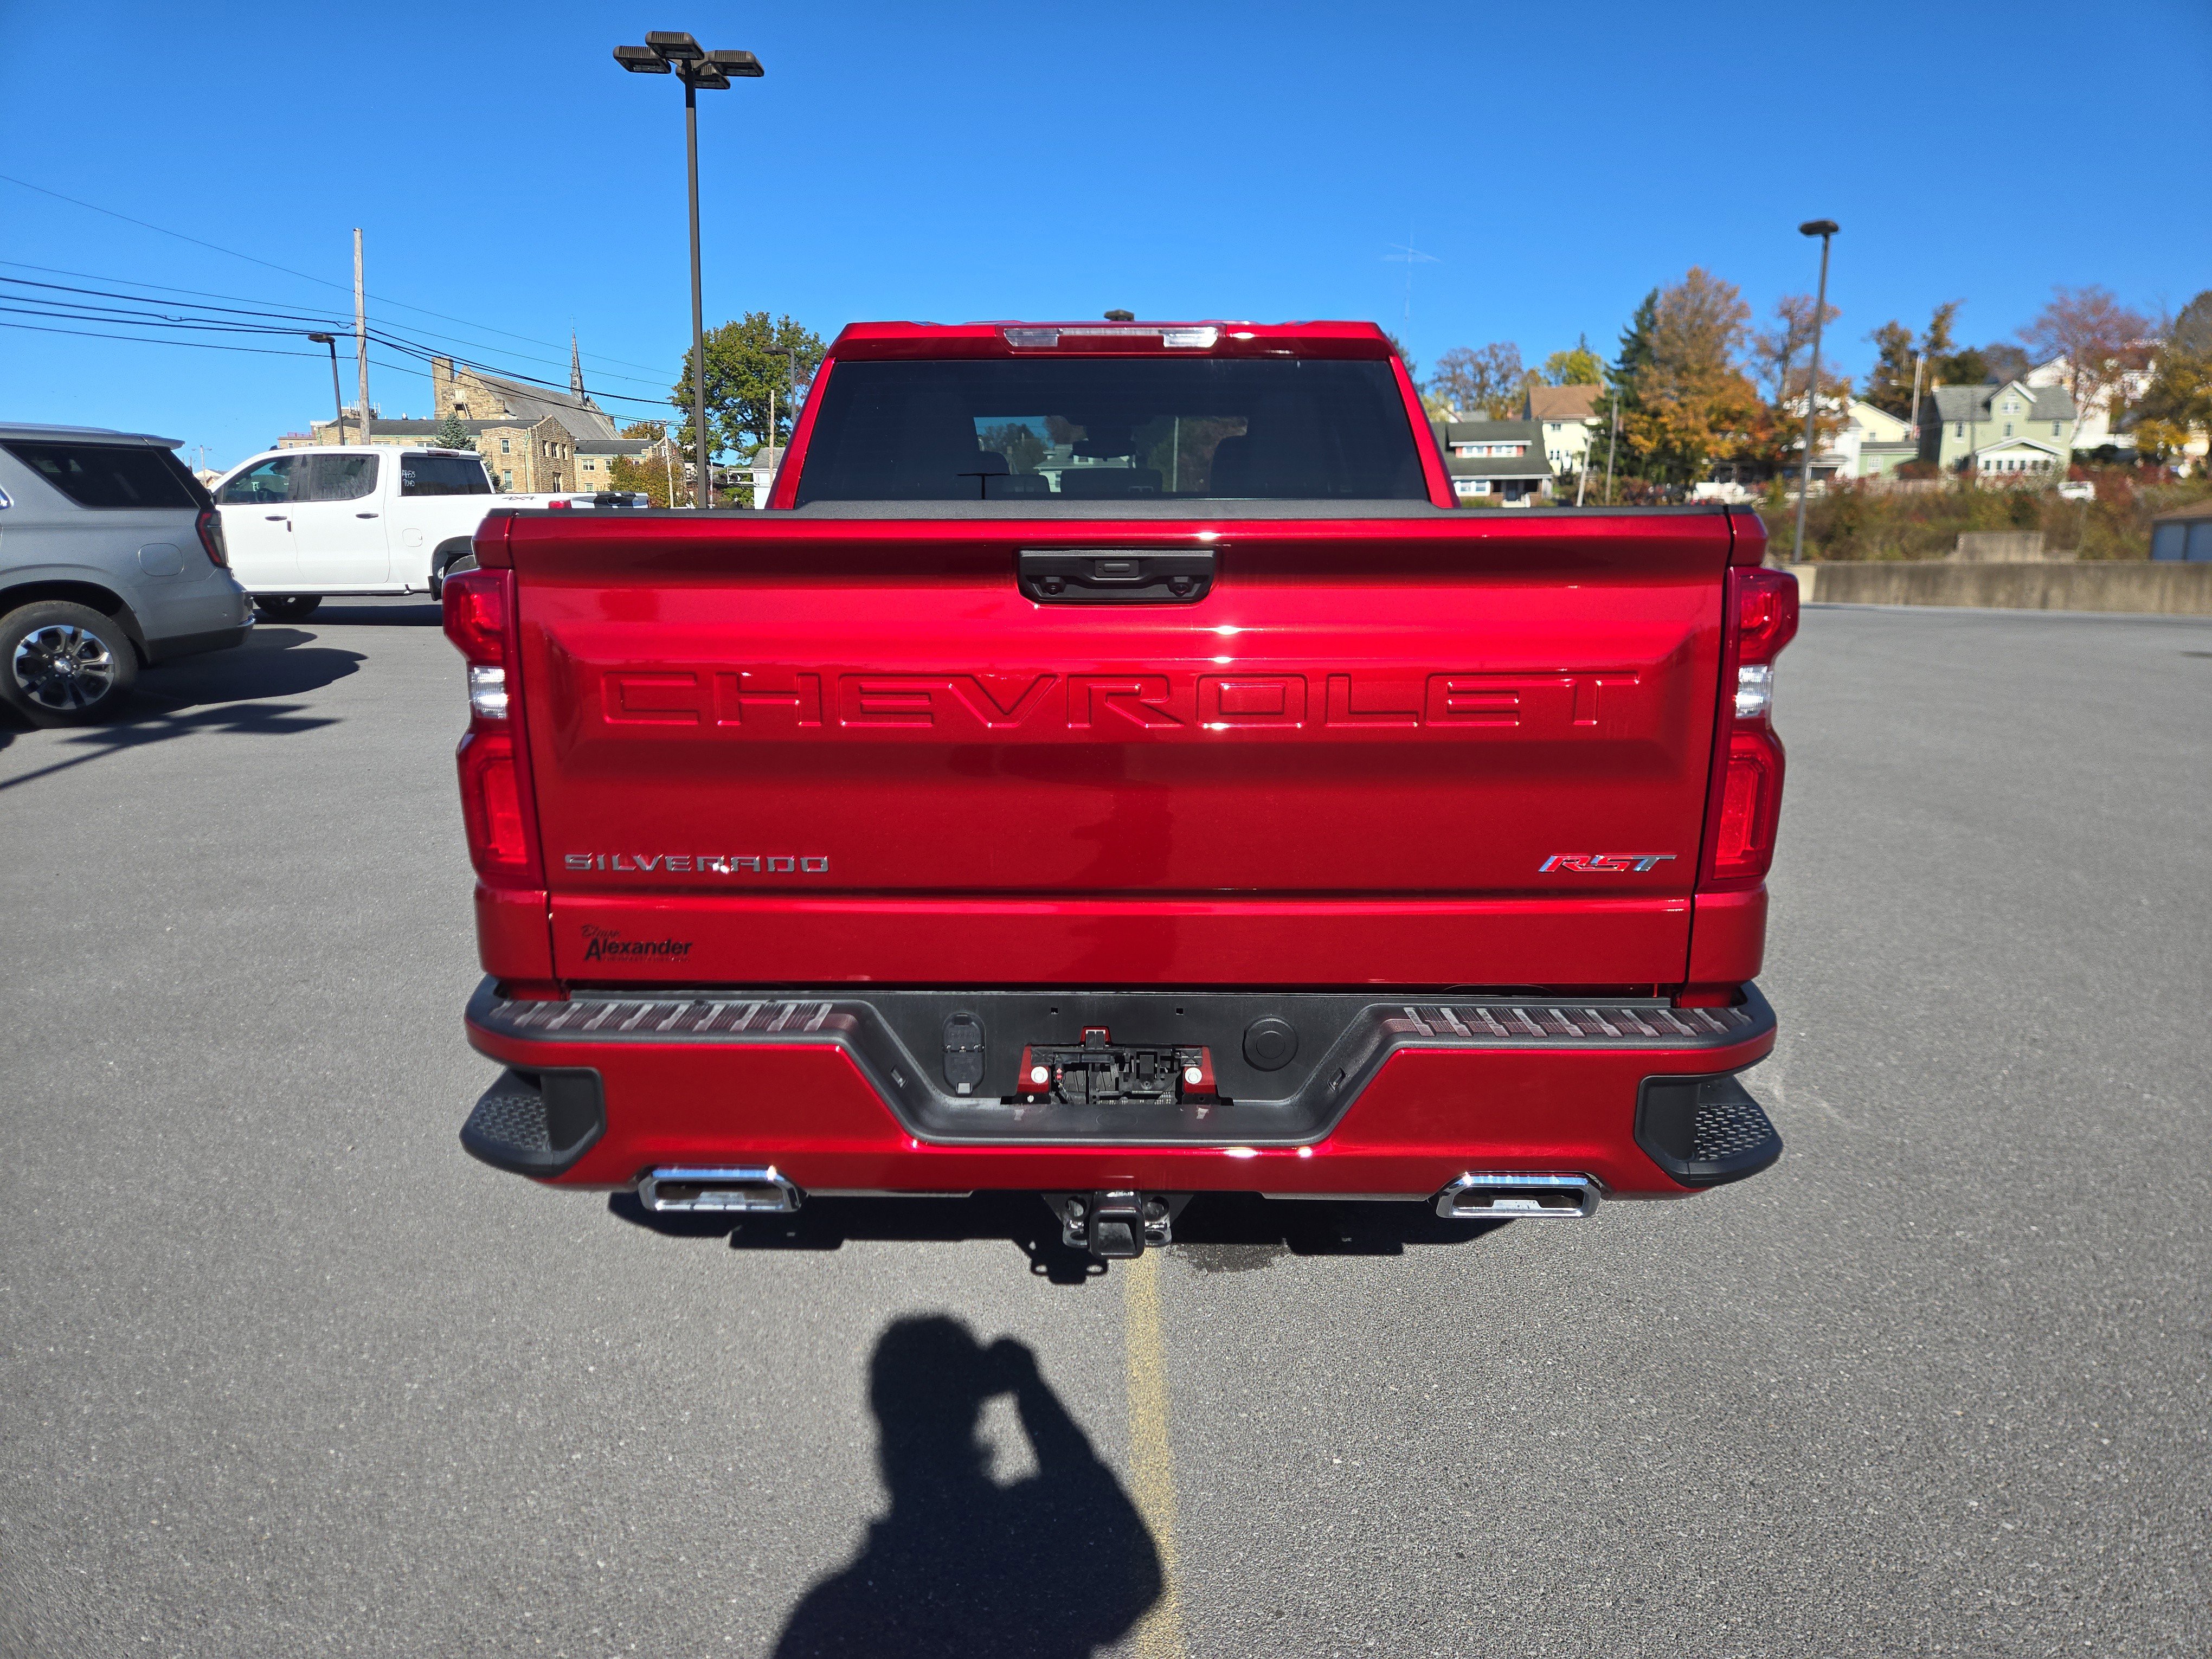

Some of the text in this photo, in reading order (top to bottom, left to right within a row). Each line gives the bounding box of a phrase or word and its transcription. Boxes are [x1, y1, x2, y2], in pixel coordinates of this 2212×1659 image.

[602, 671, 1640, 728] CHEVROLET
[564, 853, 829, 873] SILVERADO
[1539, 854, 1677, 872] RST
[584, 937, 693, 961] Alexander
